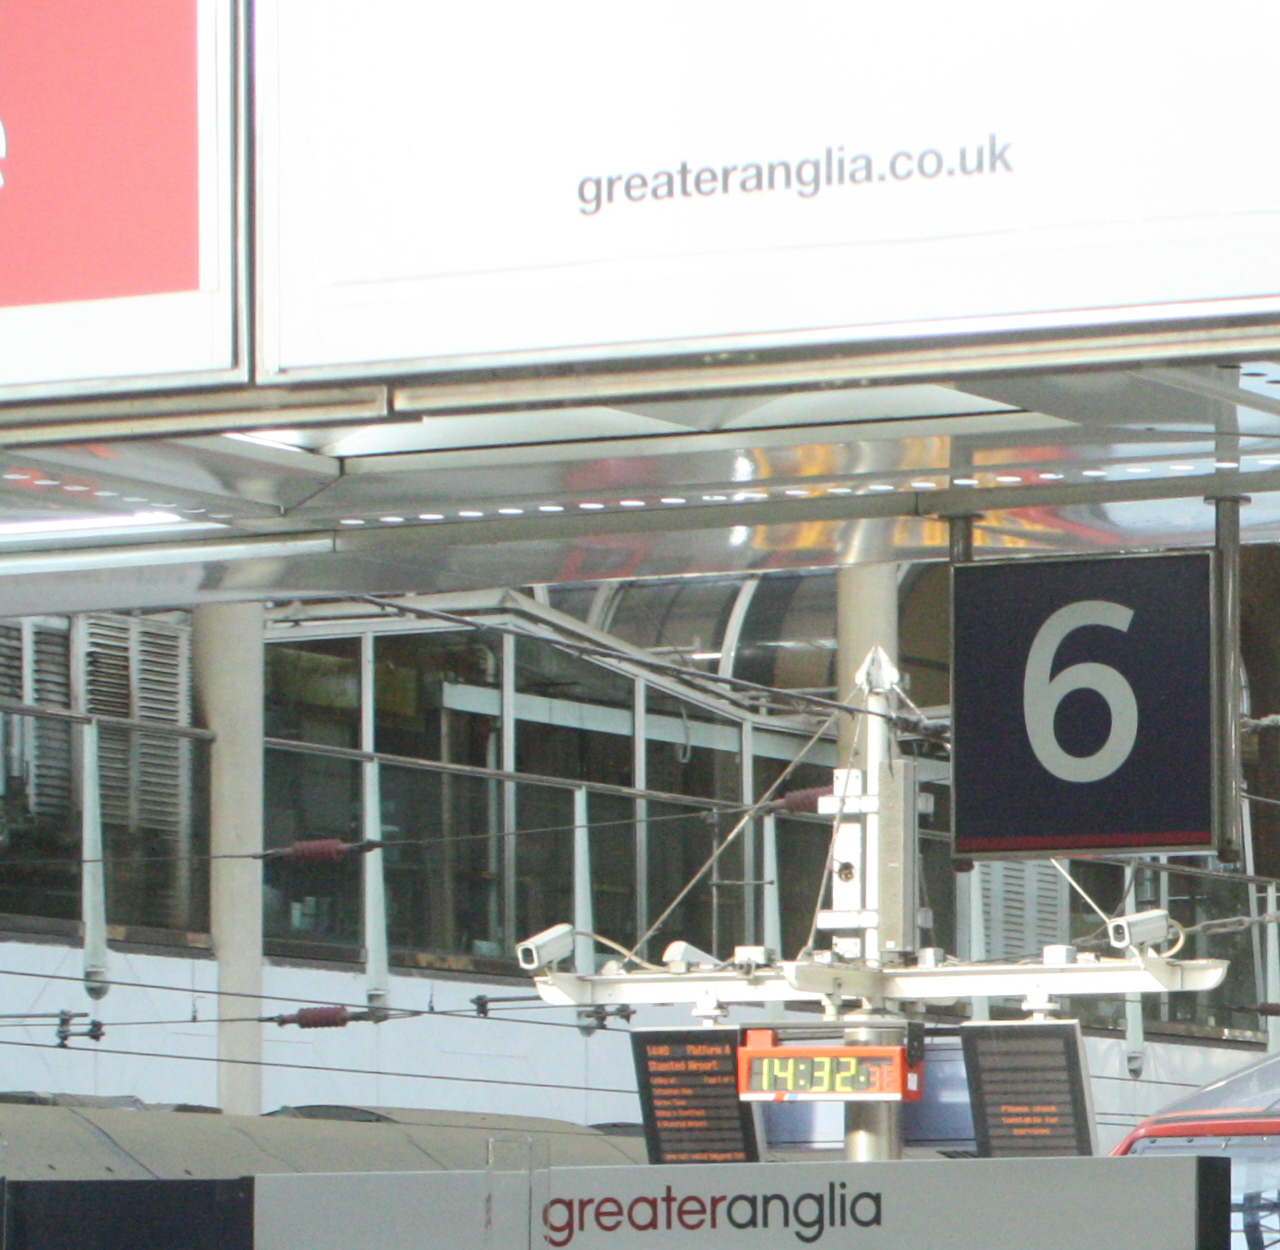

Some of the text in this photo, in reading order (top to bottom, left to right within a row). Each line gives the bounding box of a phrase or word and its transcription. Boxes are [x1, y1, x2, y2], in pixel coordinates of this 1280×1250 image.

[577, 133, 1014, 216] greateranglia.co.uk
[1023, 600, 1138, 783] 6
[762, 1056, 857, 1092] 14:32
[541, 1181, 882, 1247] greateranglia
